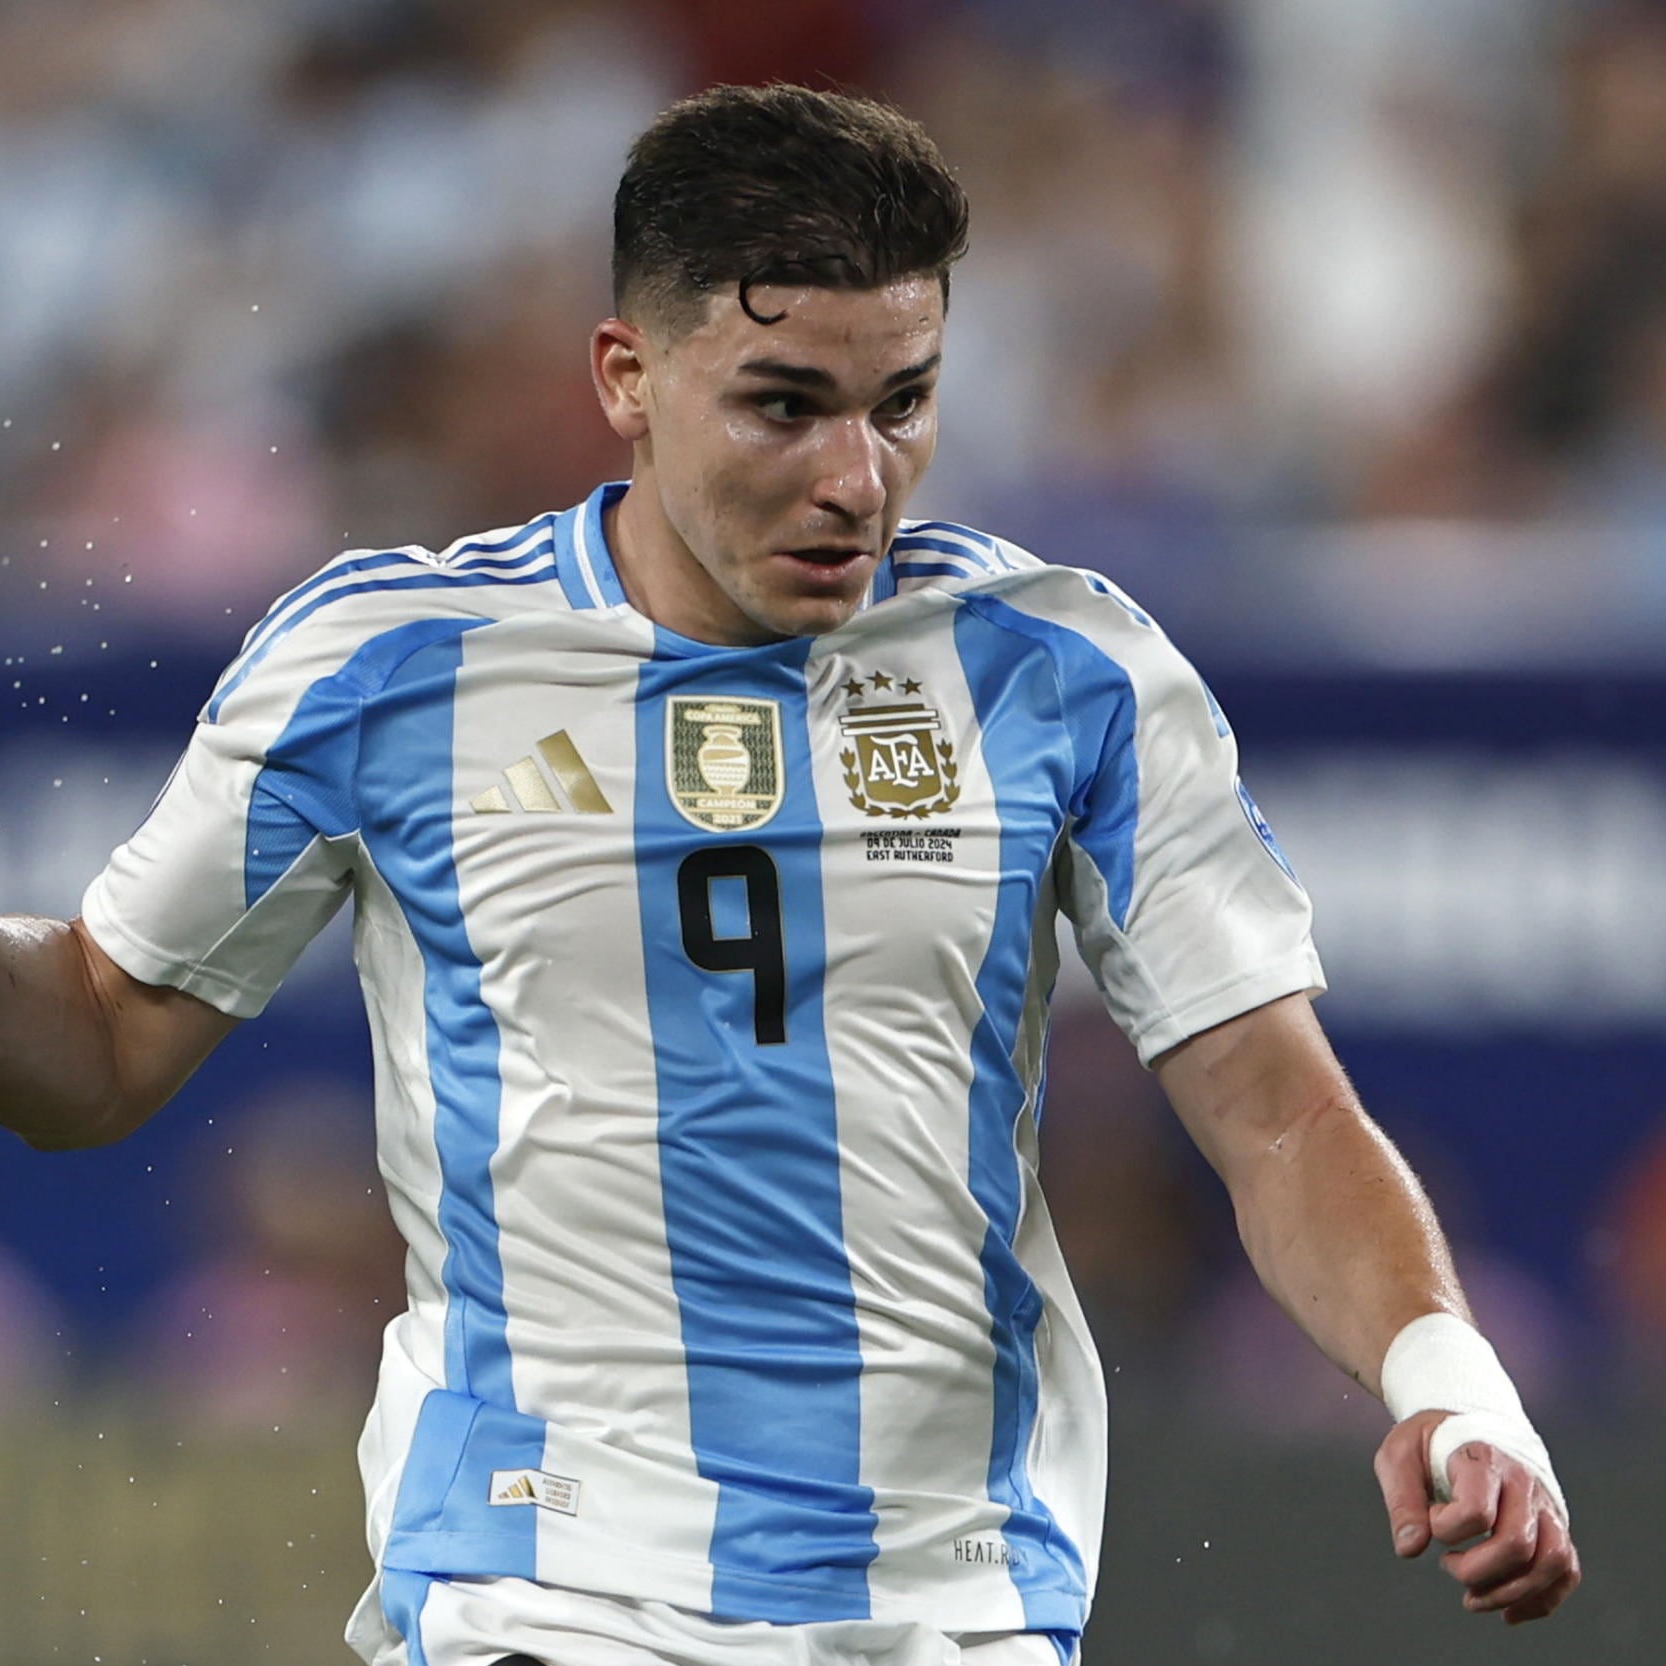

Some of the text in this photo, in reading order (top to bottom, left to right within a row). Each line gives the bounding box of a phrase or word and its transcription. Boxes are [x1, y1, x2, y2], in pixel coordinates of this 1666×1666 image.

[868, 732, 935, 788] AFA
[866, 837, 953, 850] 09 DE JULIO 2024
[866, 850, 954, 862] EAST RUTHERFORD
[677, 844, 787, 1045] 9
